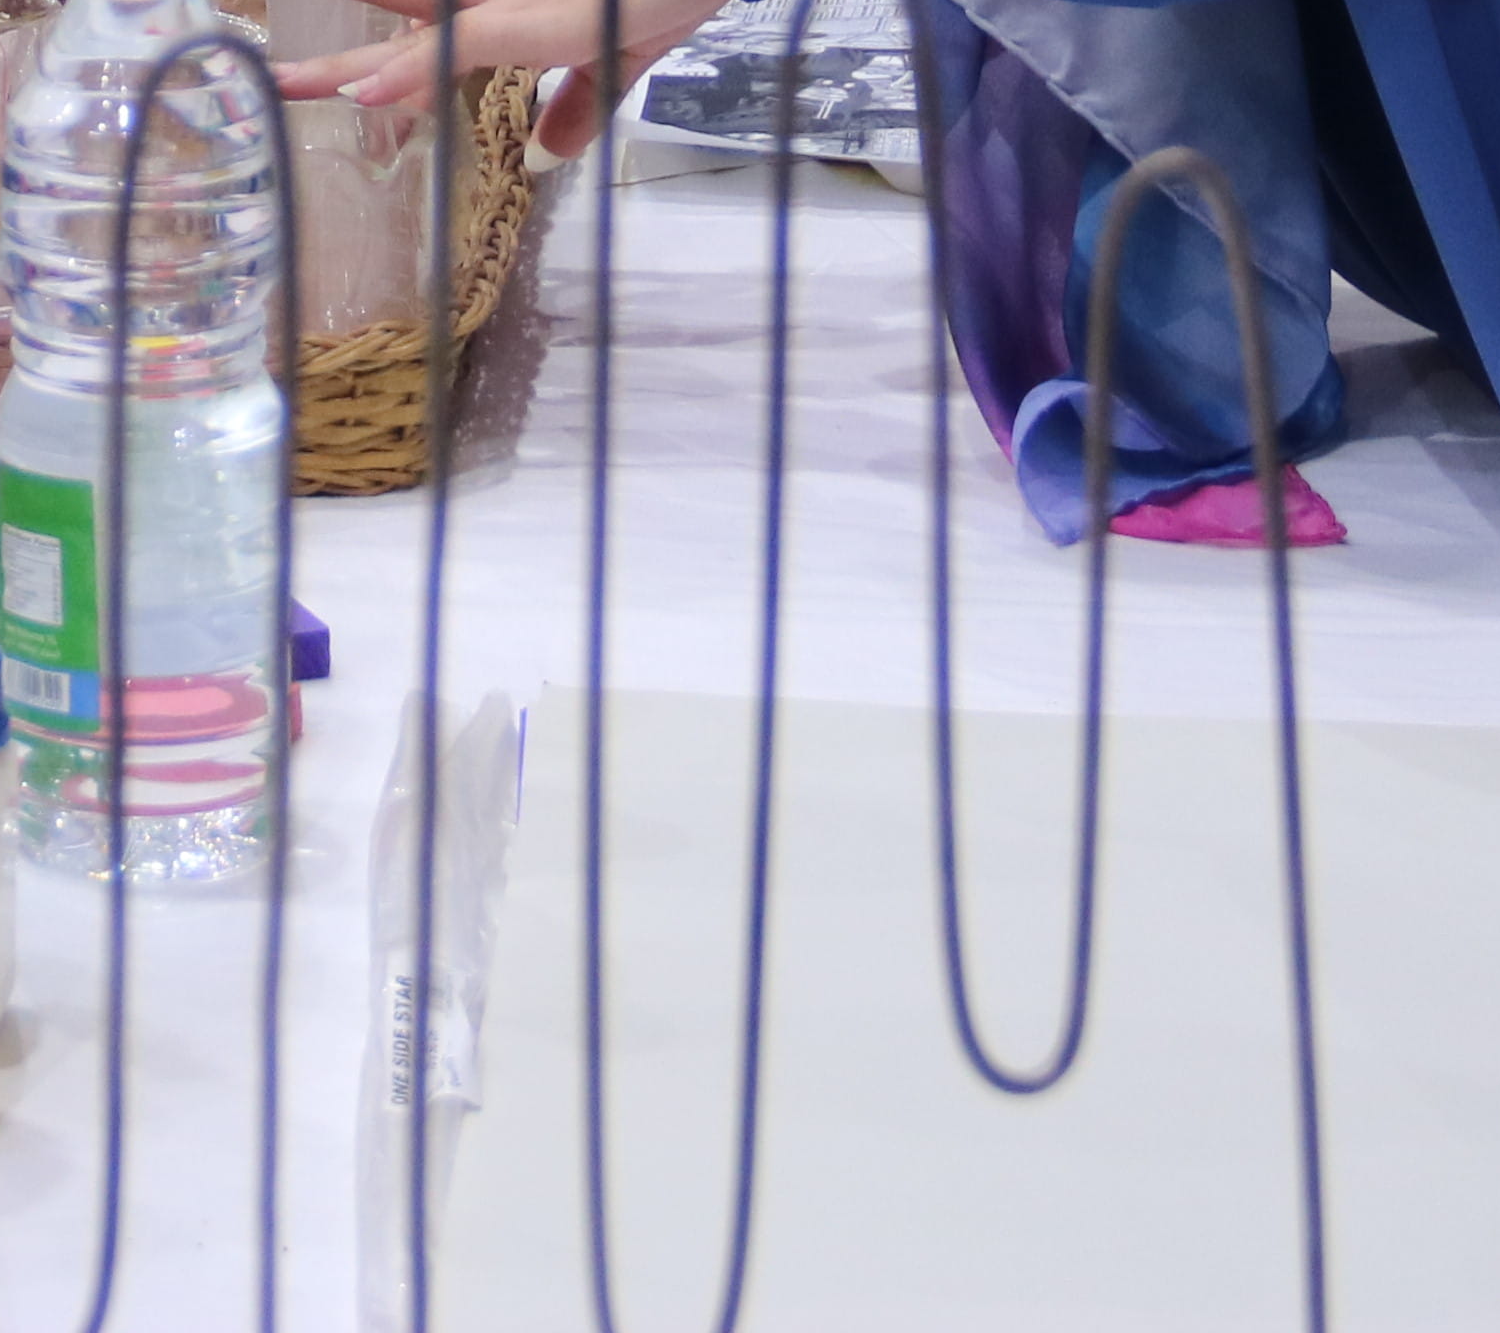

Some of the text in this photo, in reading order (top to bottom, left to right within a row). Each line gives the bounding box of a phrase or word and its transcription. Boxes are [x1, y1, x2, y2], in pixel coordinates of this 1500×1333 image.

[391, 975, 413, 1105] ONE SIDE STAR
